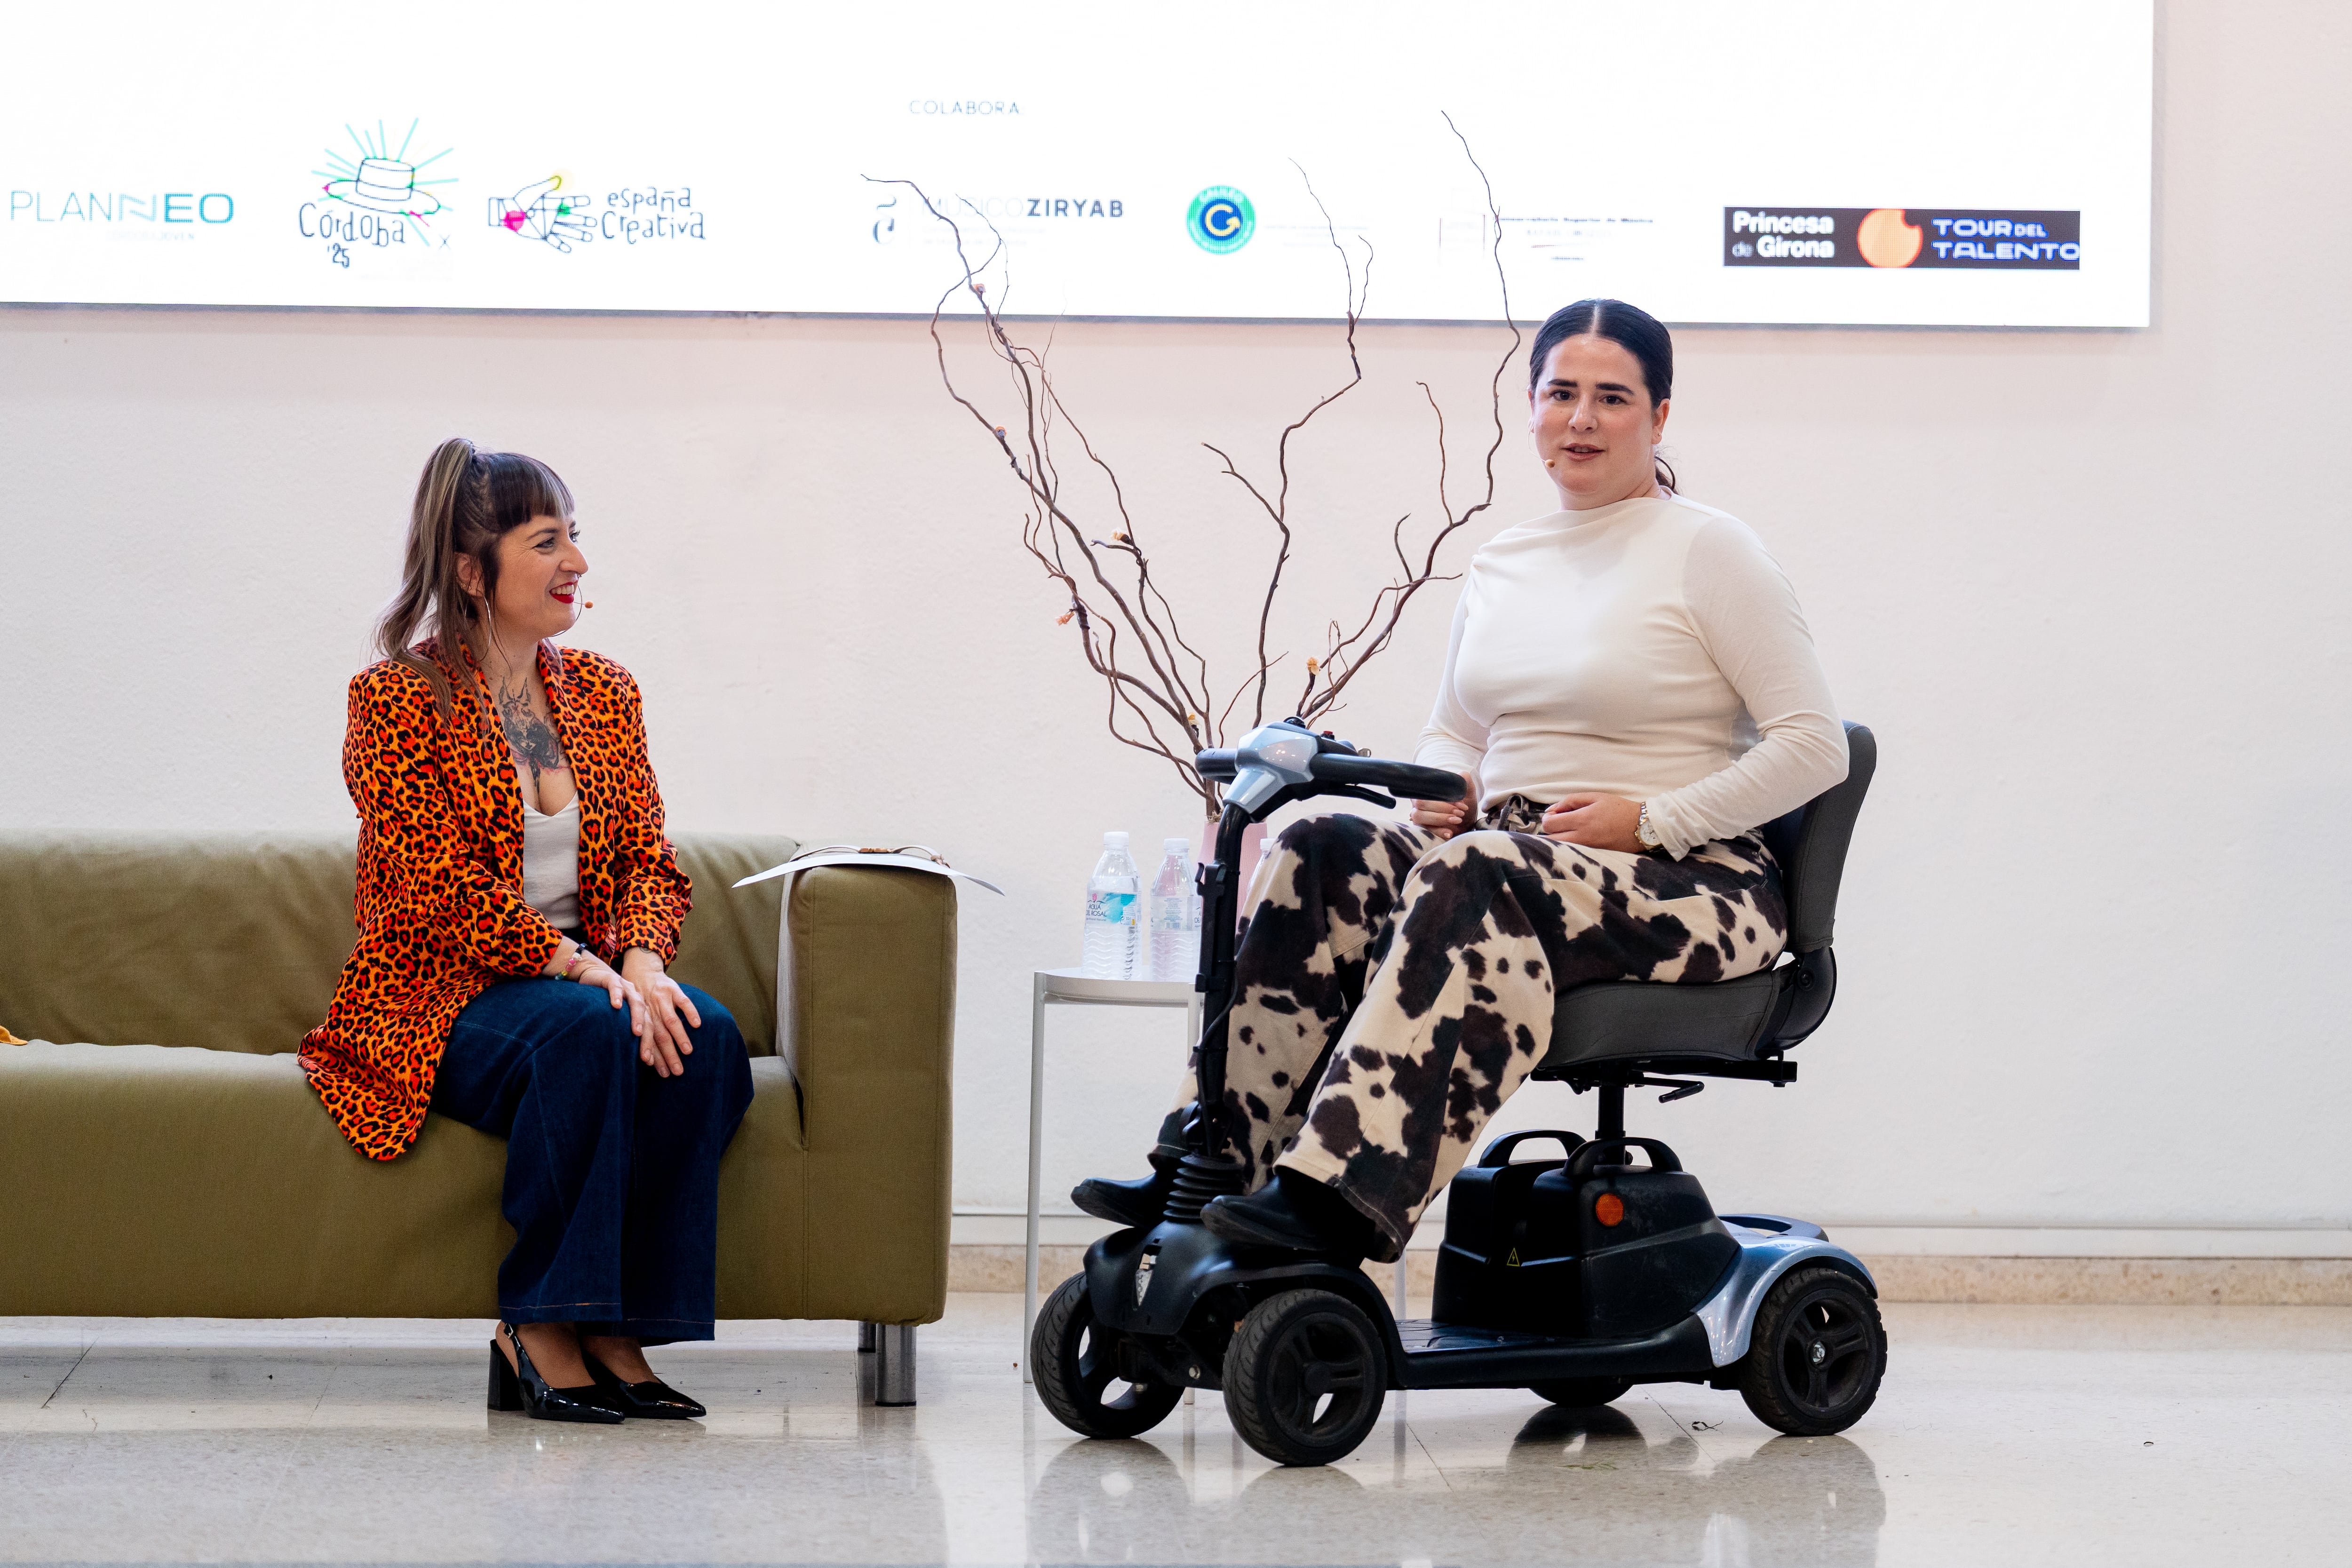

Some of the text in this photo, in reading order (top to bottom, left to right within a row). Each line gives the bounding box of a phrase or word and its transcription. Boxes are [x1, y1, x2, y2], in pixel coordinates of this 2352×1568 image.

[10, 190, 235, 224] PLANNEO
[607, 186, 691, 215] españa
[299, 201, 406, 248] Córdoba
[602, 211, 707, 245] Creativa
[1733, 210, 1834, 234] Princesa
[1931, 218, 2049, 238] TOUR DEL
[1756, 235, 1835, 258] Girona
[1931, 240, 2080, 261] TALENTO
